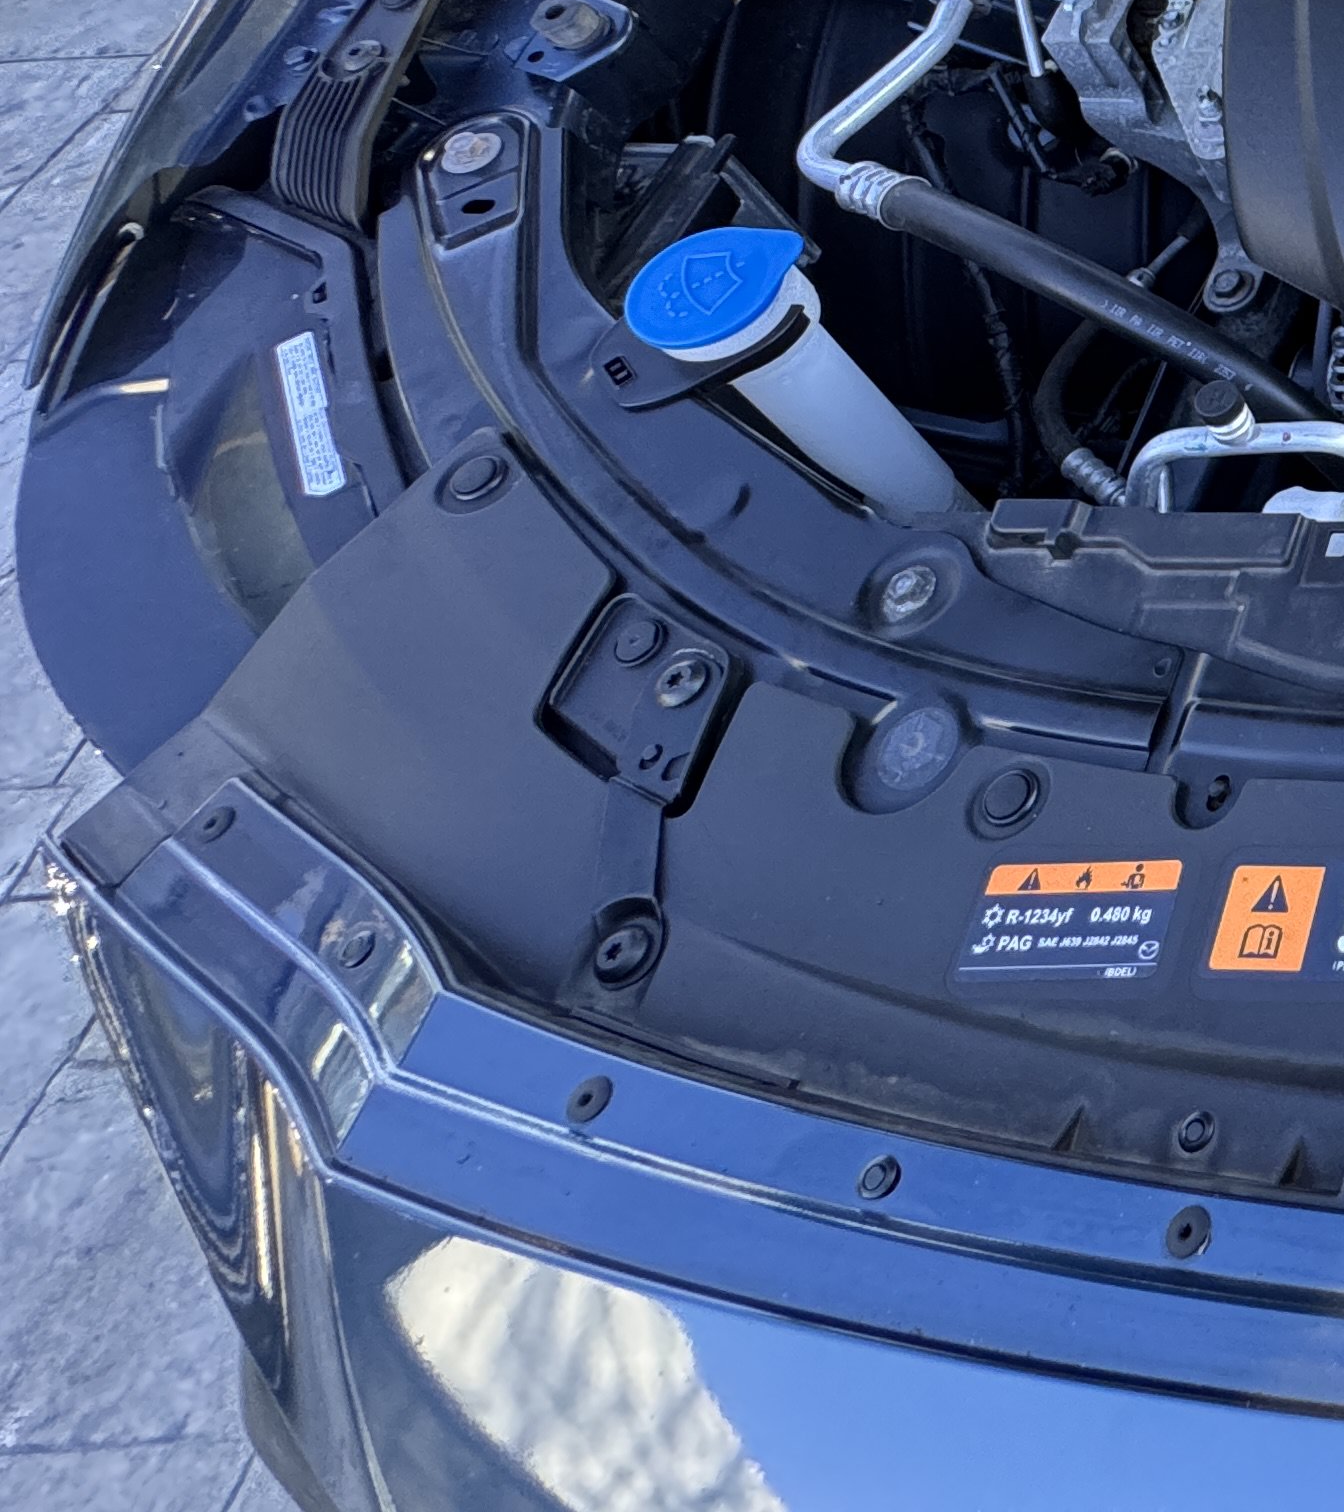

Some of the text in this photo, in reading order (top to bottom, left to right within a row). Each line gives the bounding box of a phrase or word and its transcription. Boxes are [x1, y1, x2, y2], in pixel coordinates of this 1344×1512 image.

[1005, 905, 1153, 927] R-1234yf 0.480 kg
[996, 935, 1033, 952] PAG
